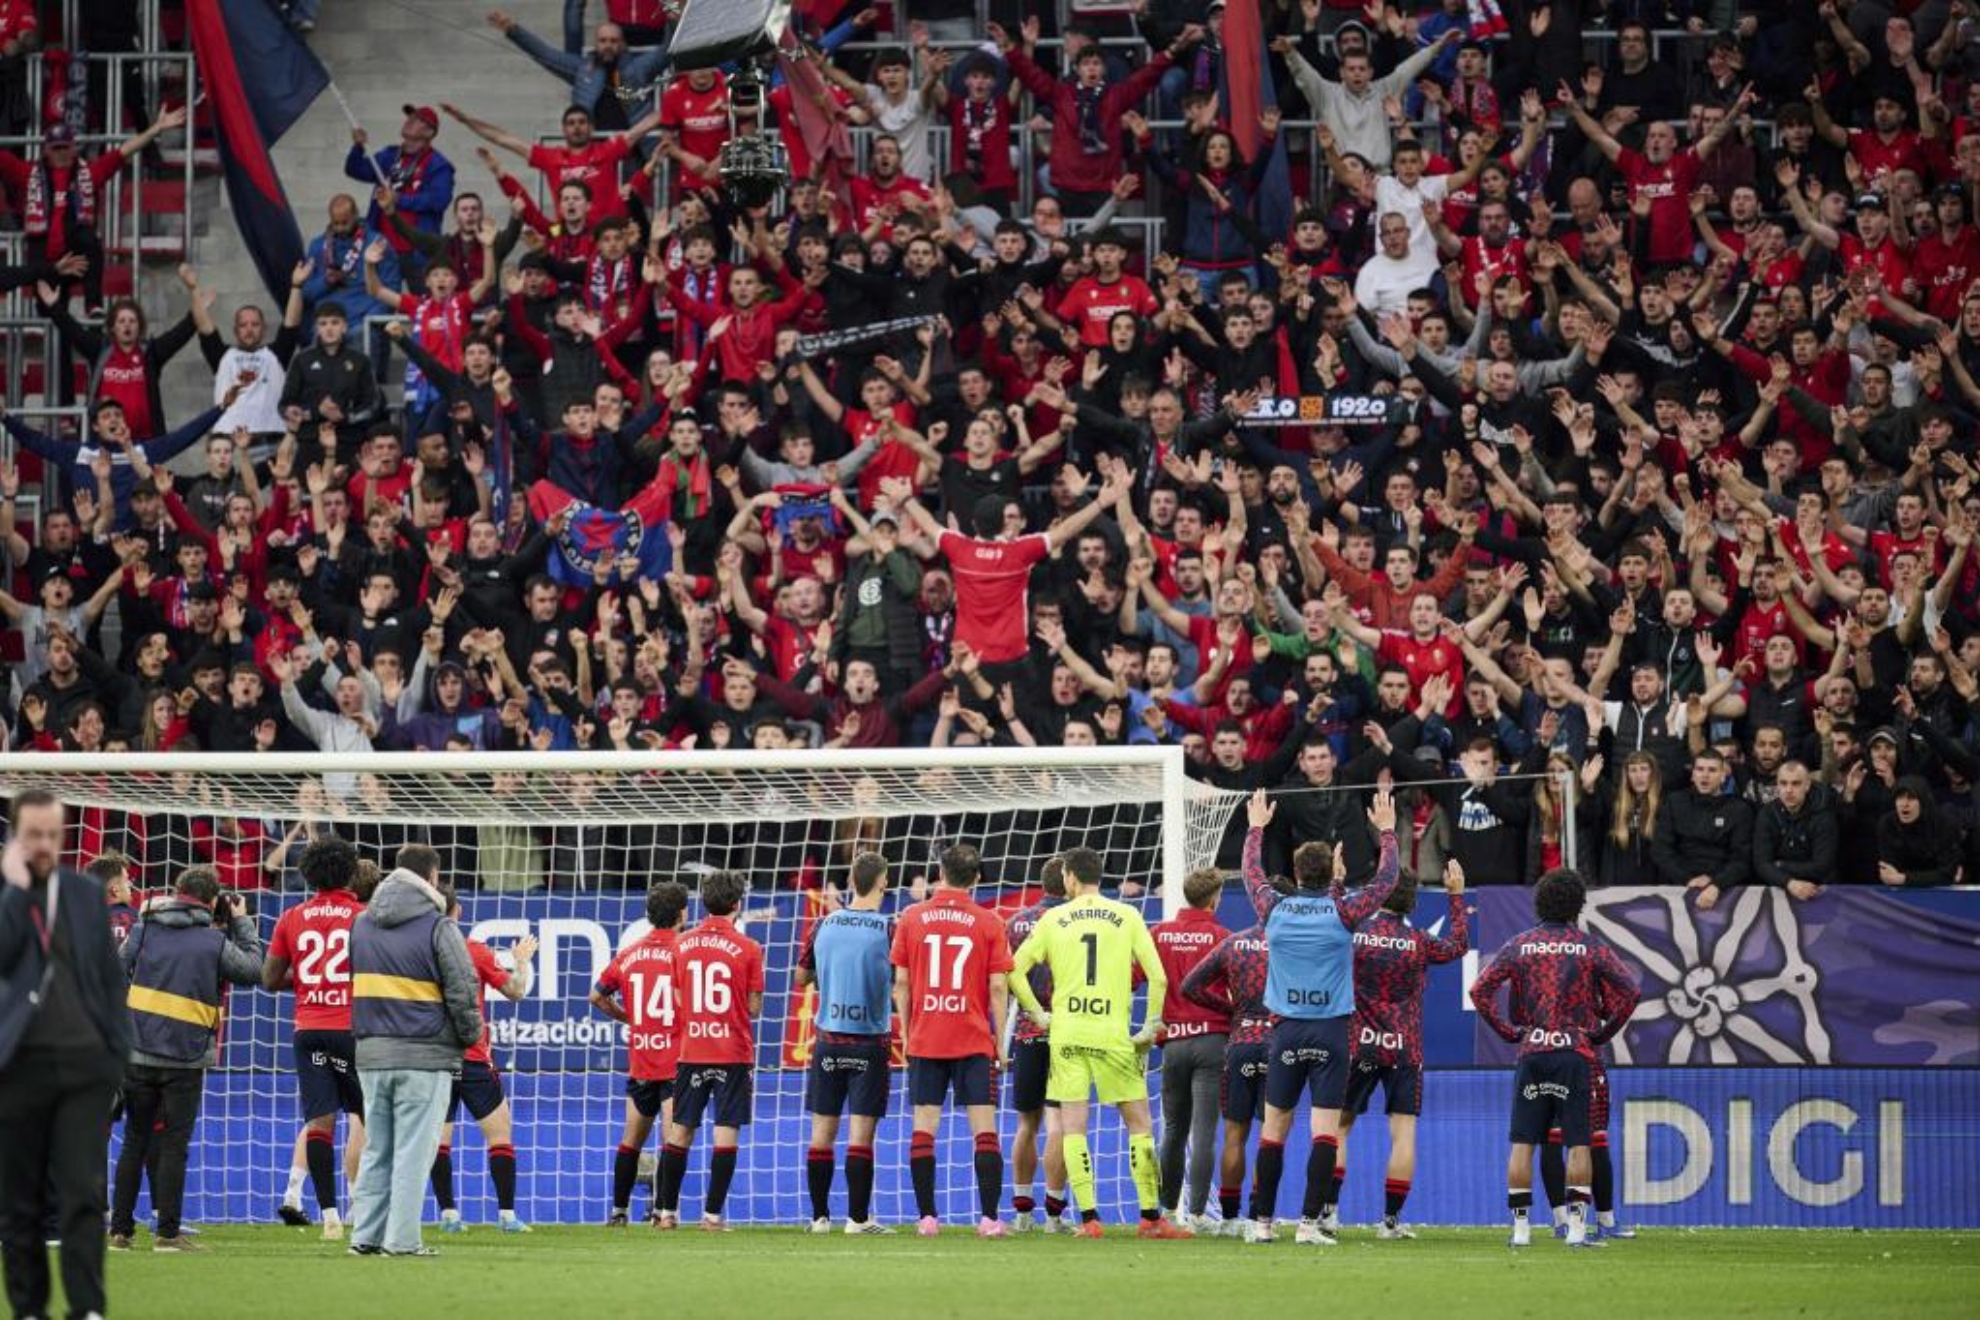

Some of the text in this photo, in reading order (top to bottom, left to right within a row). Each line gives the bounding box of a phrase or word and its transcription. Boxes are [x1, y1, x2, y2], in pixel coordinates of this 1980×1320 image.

[1069, 908, 1124, 929] HERRERA
[701, 934, 744, 958] GÓMEZ
[1157, 931, 1214, 945] macron
[1233, 938, 1269, 951] mac
[1353, 931, 1417, 951] macron
[297, 928, 350, 985] 22
[1520, 941, 1587, 956] macron
[923, 933, 974, 990] 17
[1080, 932, 1098, 986] 1
[686, 959, 732, 1014] 16
[632, 972, 675, 1027] 14
[923, 993, 966, 1012] DIGI
[1068, 996, 1111, 1015] DIGI
[1287, 988, 1330, 1006] DIGI
[830, 1003, 868, 1022] DIGI
[689, 1021, 730, 1038] DIGI
[1360, 1027, 1404, 1049] DIGI
[1529, 1028, 1572, 1046] DIGI
[633, 1032, 671, 1050] DIGI
[1623, 1098, 1903, 1207] DIGI
